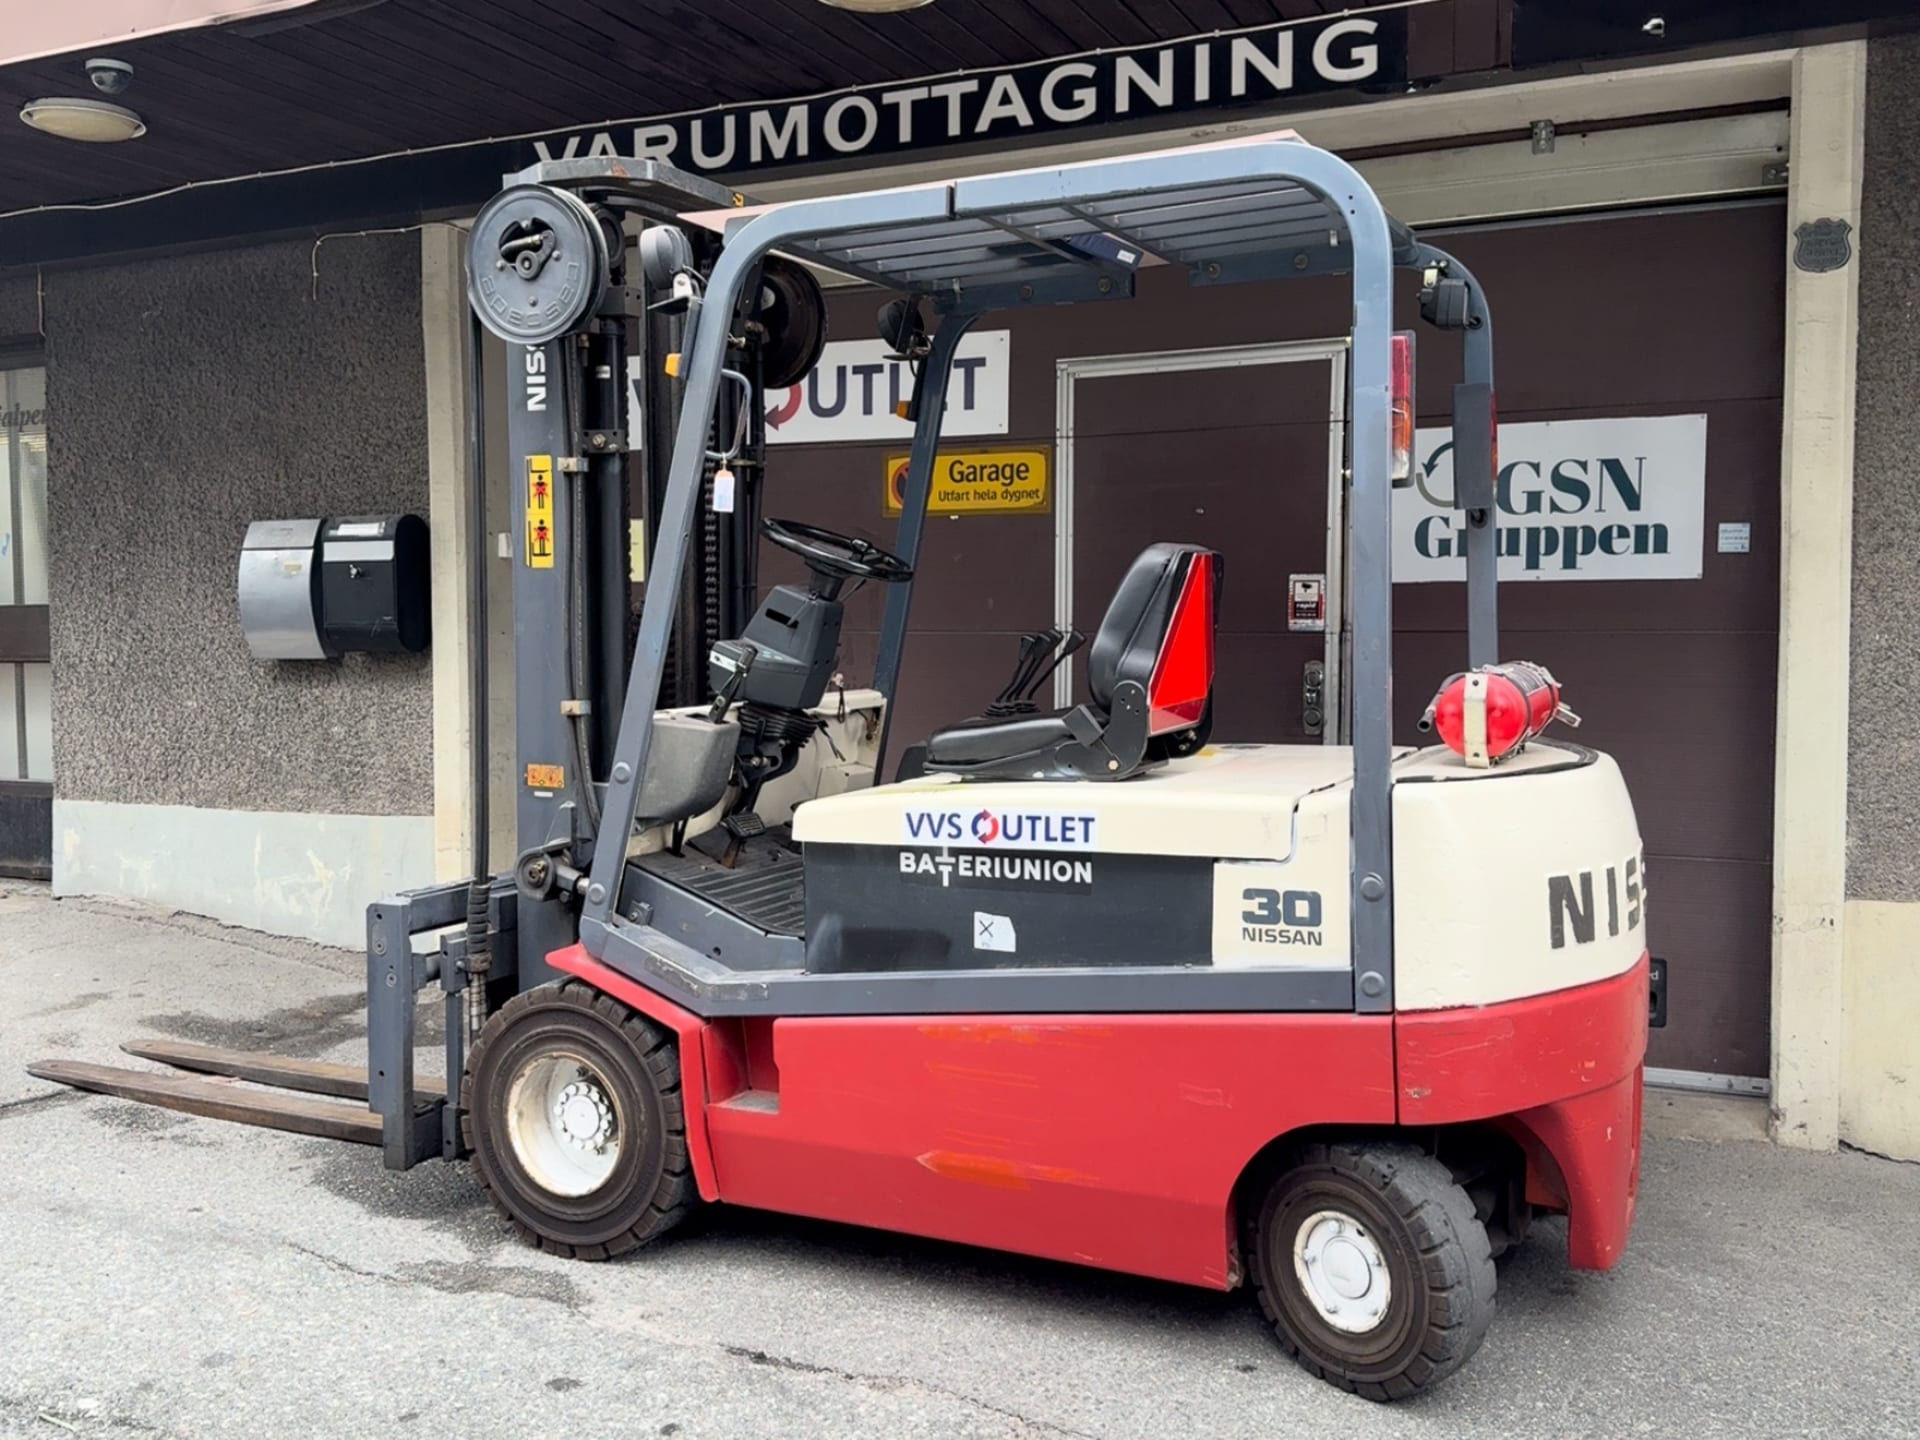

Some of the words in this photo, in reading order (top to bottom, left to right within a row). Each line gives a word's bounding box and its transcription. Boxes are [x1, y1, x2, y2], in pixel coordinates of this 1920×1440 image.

[526, 344, 546, 411] NIS
[765, 357, 986, 430] UTLT
[949, 460, 1030, 486] Garage
[1495, 457, 1647, 515] GSN
[938, 490, 970, 502] Utfart
[973, 489, 997, 501] hela
[1001, 488, 1040, 503] dygnet
[906, 812, 963, 840] VVS
[971, 809, 1095, 845] OUTLET
[1242, 888, 1322, 927] 30
[1548, 856, 1648, 949] NIS
[1242, 927, 1322, 946] NISSAN
